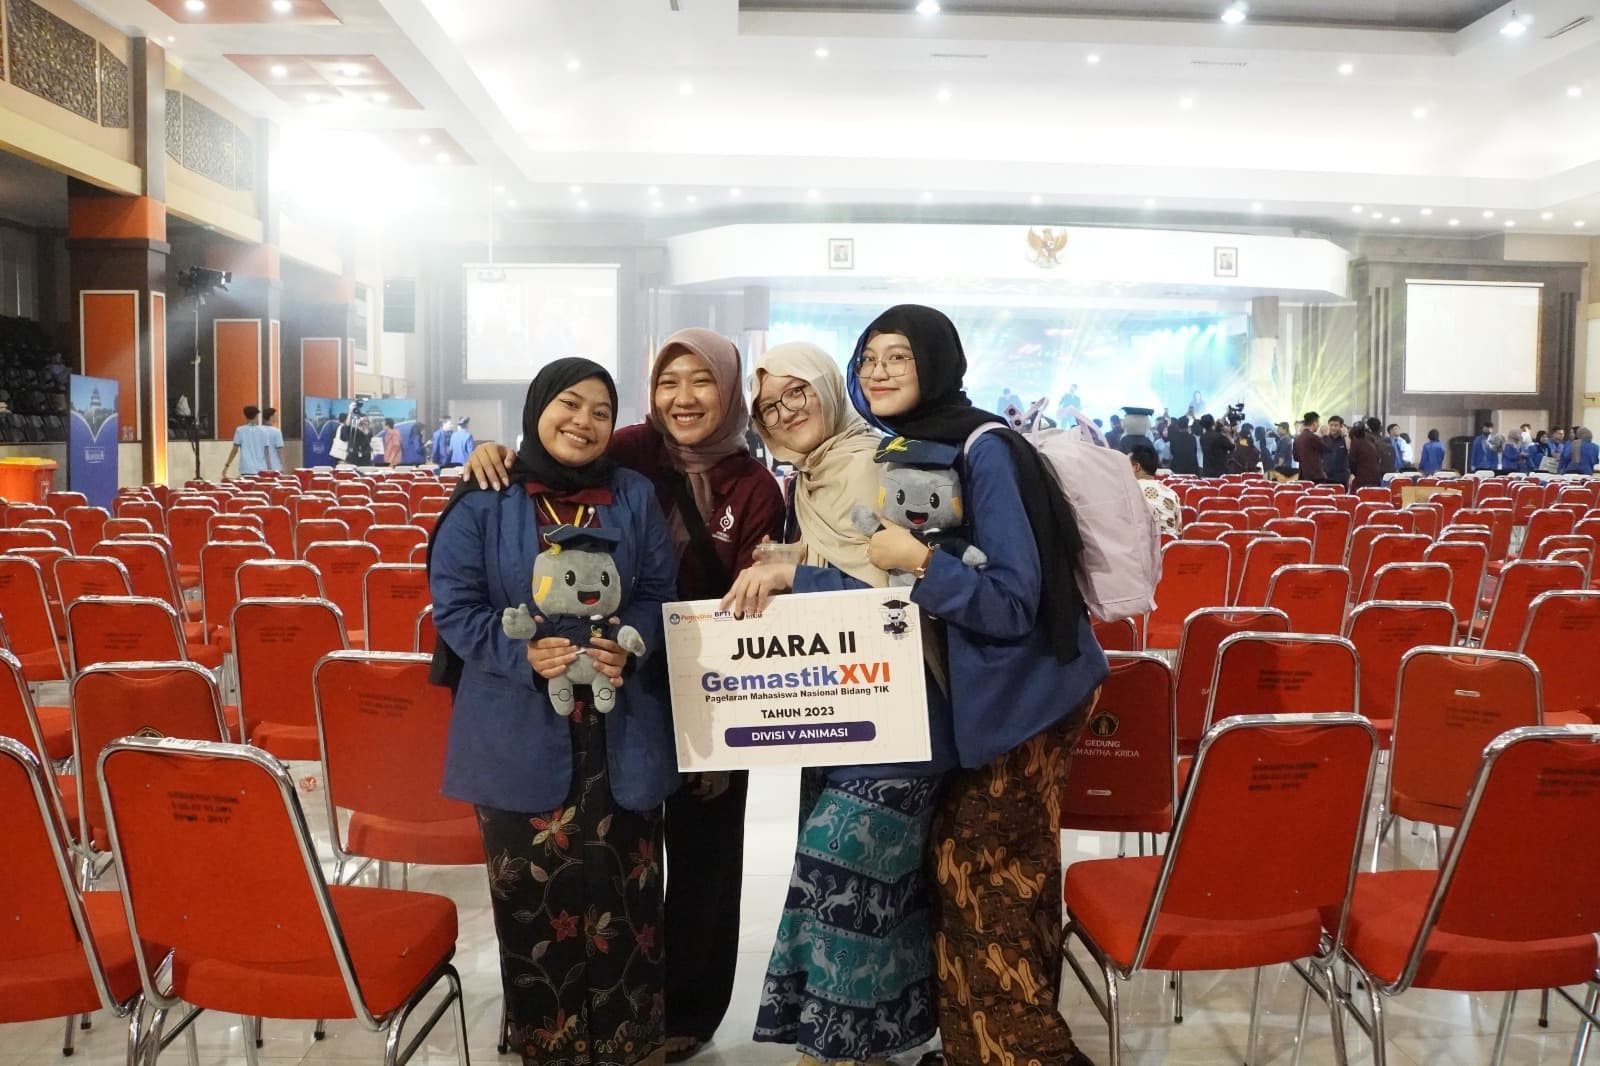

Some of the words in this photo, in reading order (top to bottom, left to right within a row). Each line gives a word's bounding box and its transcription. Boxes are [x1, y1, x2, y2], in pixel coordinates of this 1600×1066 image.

[731, 633, 830, 661] JUARA
[838, 631, 857, 654] II
[701, 662, 891, 692] GemastikXVI
[705, 692, 748, 703] Pagelaran
[750, 690, 798, 701] Mahasiswa
[800, 688, 838, 699] Nasional
[840, 685, 871, 697] Bidang
[874, 685, 890, 694] TIK
[761, 706, 801, 719] TAHUN
[804, 705, 835, 718] 2023
[751, 729, 785, 742] DIVISI
[787, 730, 796, 740] V
[799, 727, 848, 739] ANIMASI
[1085, 739, 1121, 748] GEDUNG
[1071, 748, 1111, 757] AMANTHA
[1114, 750, 1140, 758] KRIDA
